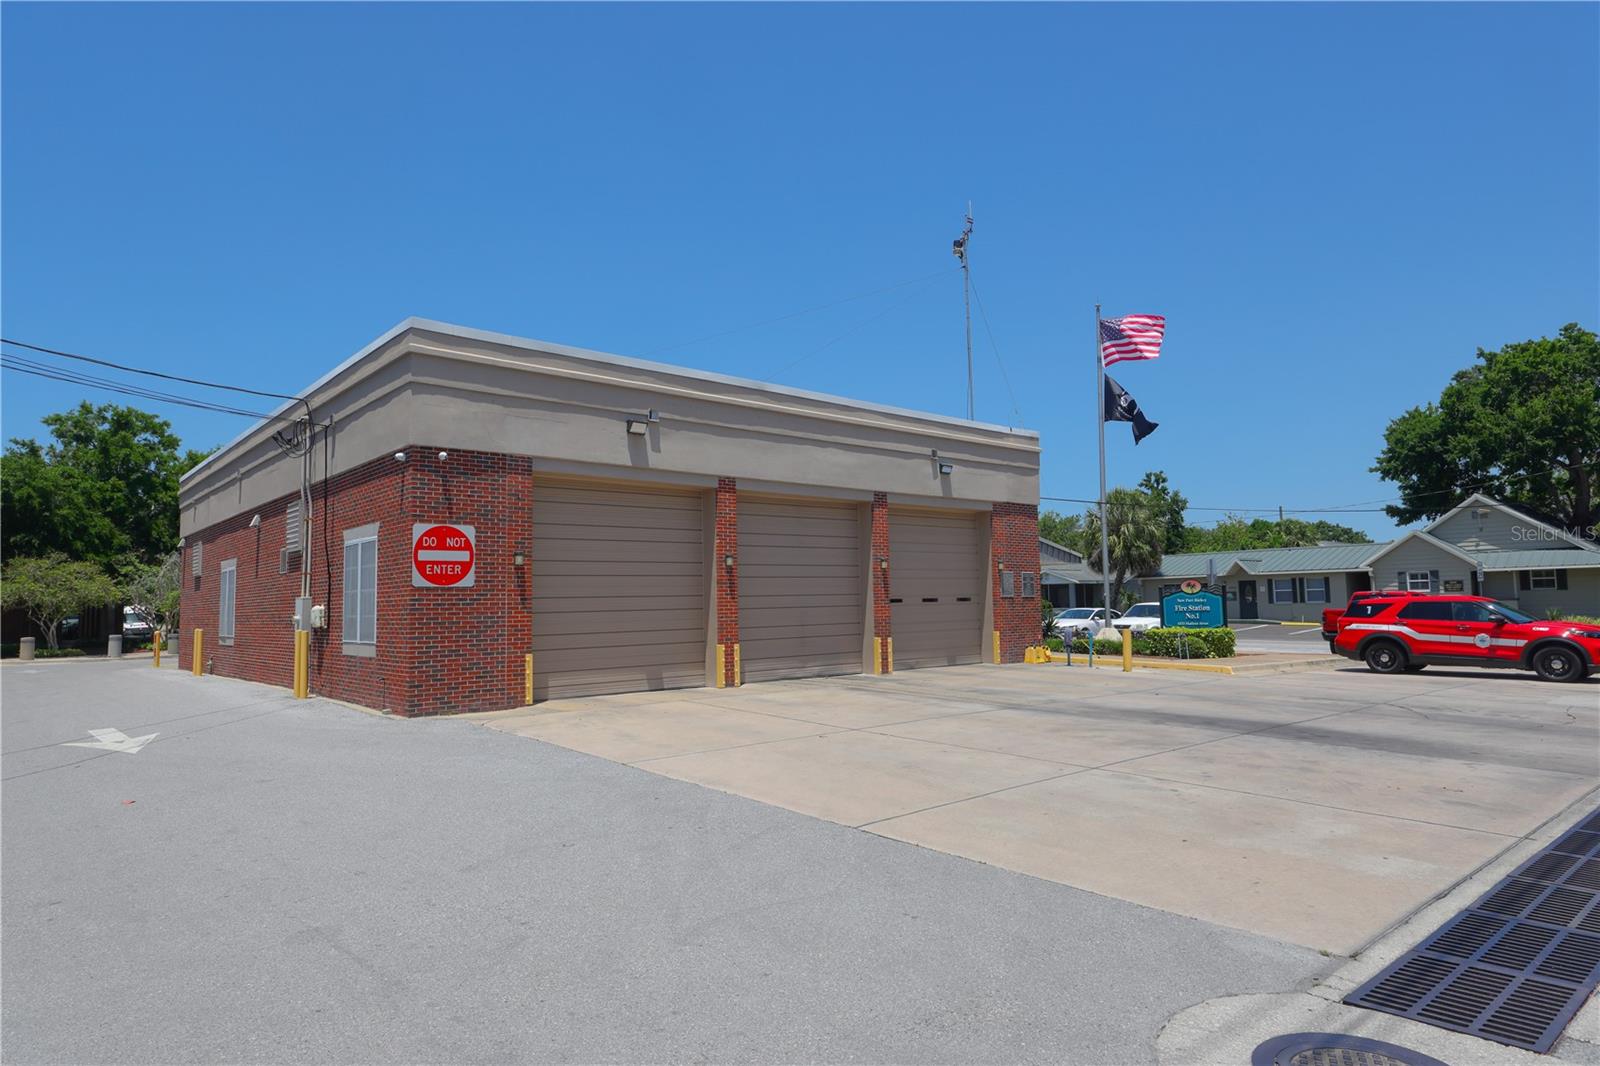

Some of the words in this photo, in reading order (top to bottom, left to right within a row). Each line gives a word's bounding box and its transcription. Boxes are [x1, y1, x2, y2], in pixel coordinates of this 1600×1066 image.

[422, 536, 437, 547] DO
[446, 537, 466, 548] NOT
[426, 564, 461, 575] ENTER
[1366, 605, 1372, 614] 1
